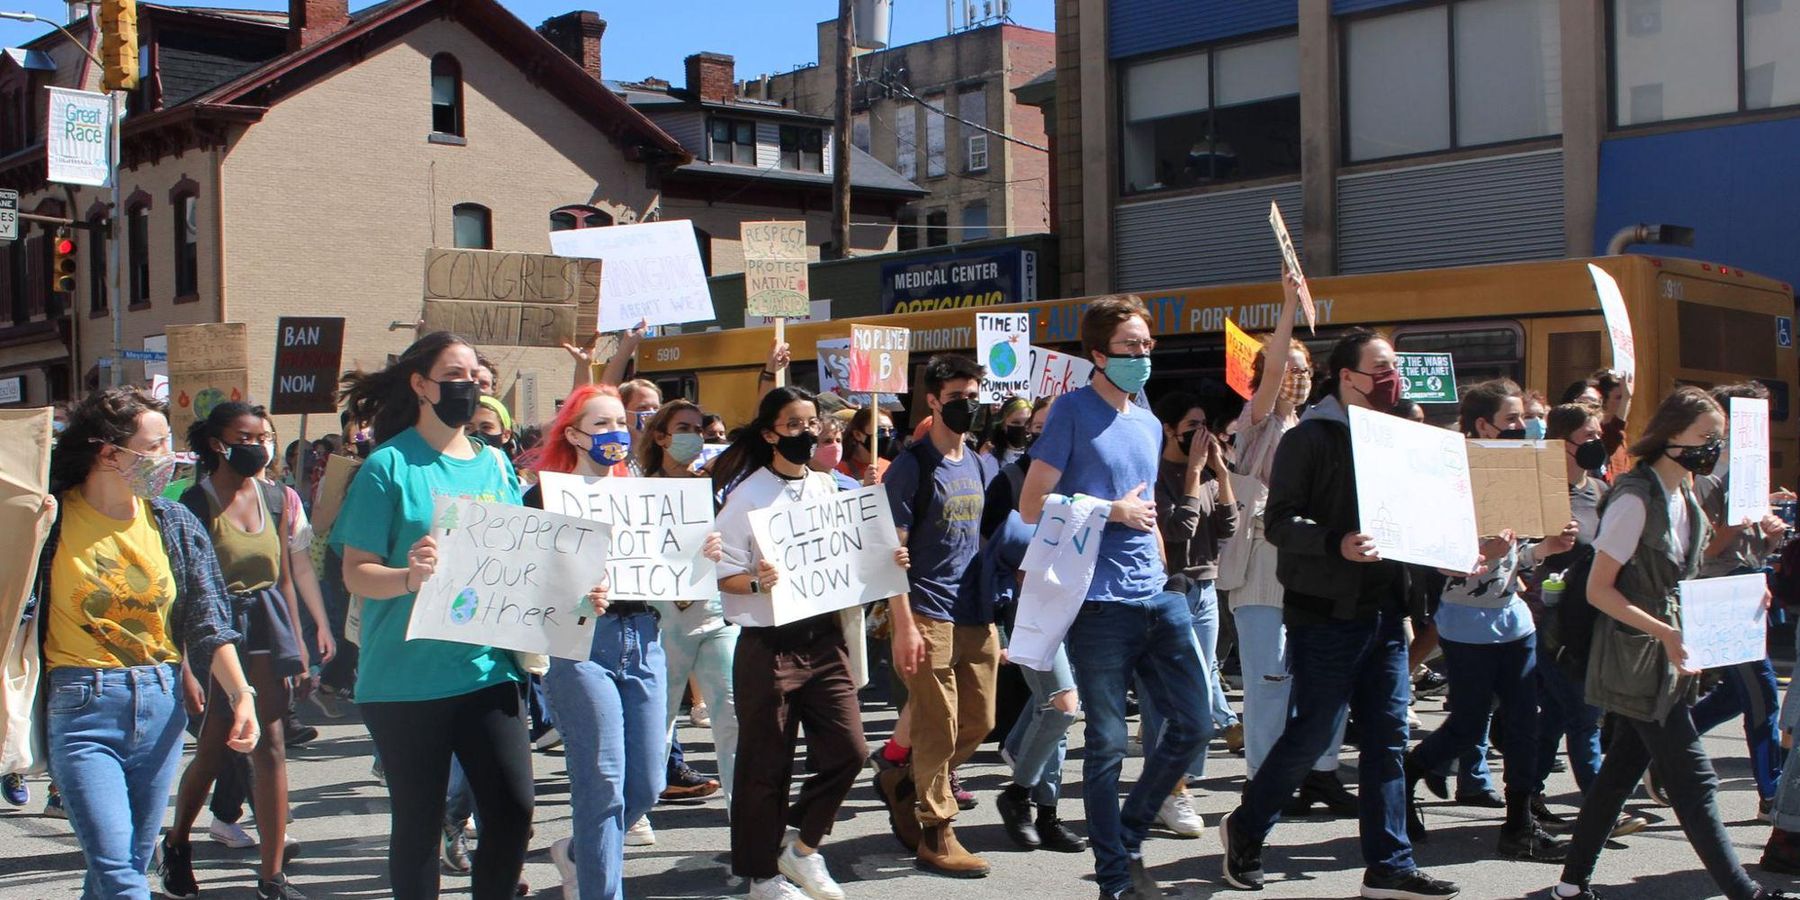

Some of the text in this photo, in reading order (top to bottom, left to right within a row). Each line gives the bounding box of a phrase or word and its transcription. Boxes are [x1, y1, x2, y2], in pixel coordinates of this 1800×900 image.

[66, 103, 102, 124] Great
[66, 121, 102, 144] Race
[746, 225, 804, 246] RESPECT
[427, 251, 602, 304] CONGRESS
[748, 259, 807, 276] PROTECT
[894, 262, 999, 290] MEDICAL CENTER
[1025, 252, 1034, 301] OPTI
[752, 276, 797, 290] NATIVE
[470, 304, 556, 343] WTF?
[979, 315, 1011, 332] TIME
[1017, 315, 1028, 333] IS
[1190, 306, 1234, 331] PORT
[284, 325, 320, 347] BAN
[853, 328, 872, 350] NO
[909, 327, 971, 351] UTHORITY
[657, 346, 680, 362] 5910
[1407, 356, 1422, 367] THE
[1424, 356, 1449, 367] WARS
[880, 352, 892, 380] B
[1406, 366, 1420, 376] THE
[1421, 366, 1449, 376] PLANET
[280, 375, 316, 394] NOW
[980, 378, 1029, 392] RUNNING
[562, 489, 708, 526] DENIAL
[769, 493, 878, 544] CLIMATE
[660, 528, 681, 553] A
[776, 526, 863, 572] CTION
[790, 563, 851, 599] NOW
